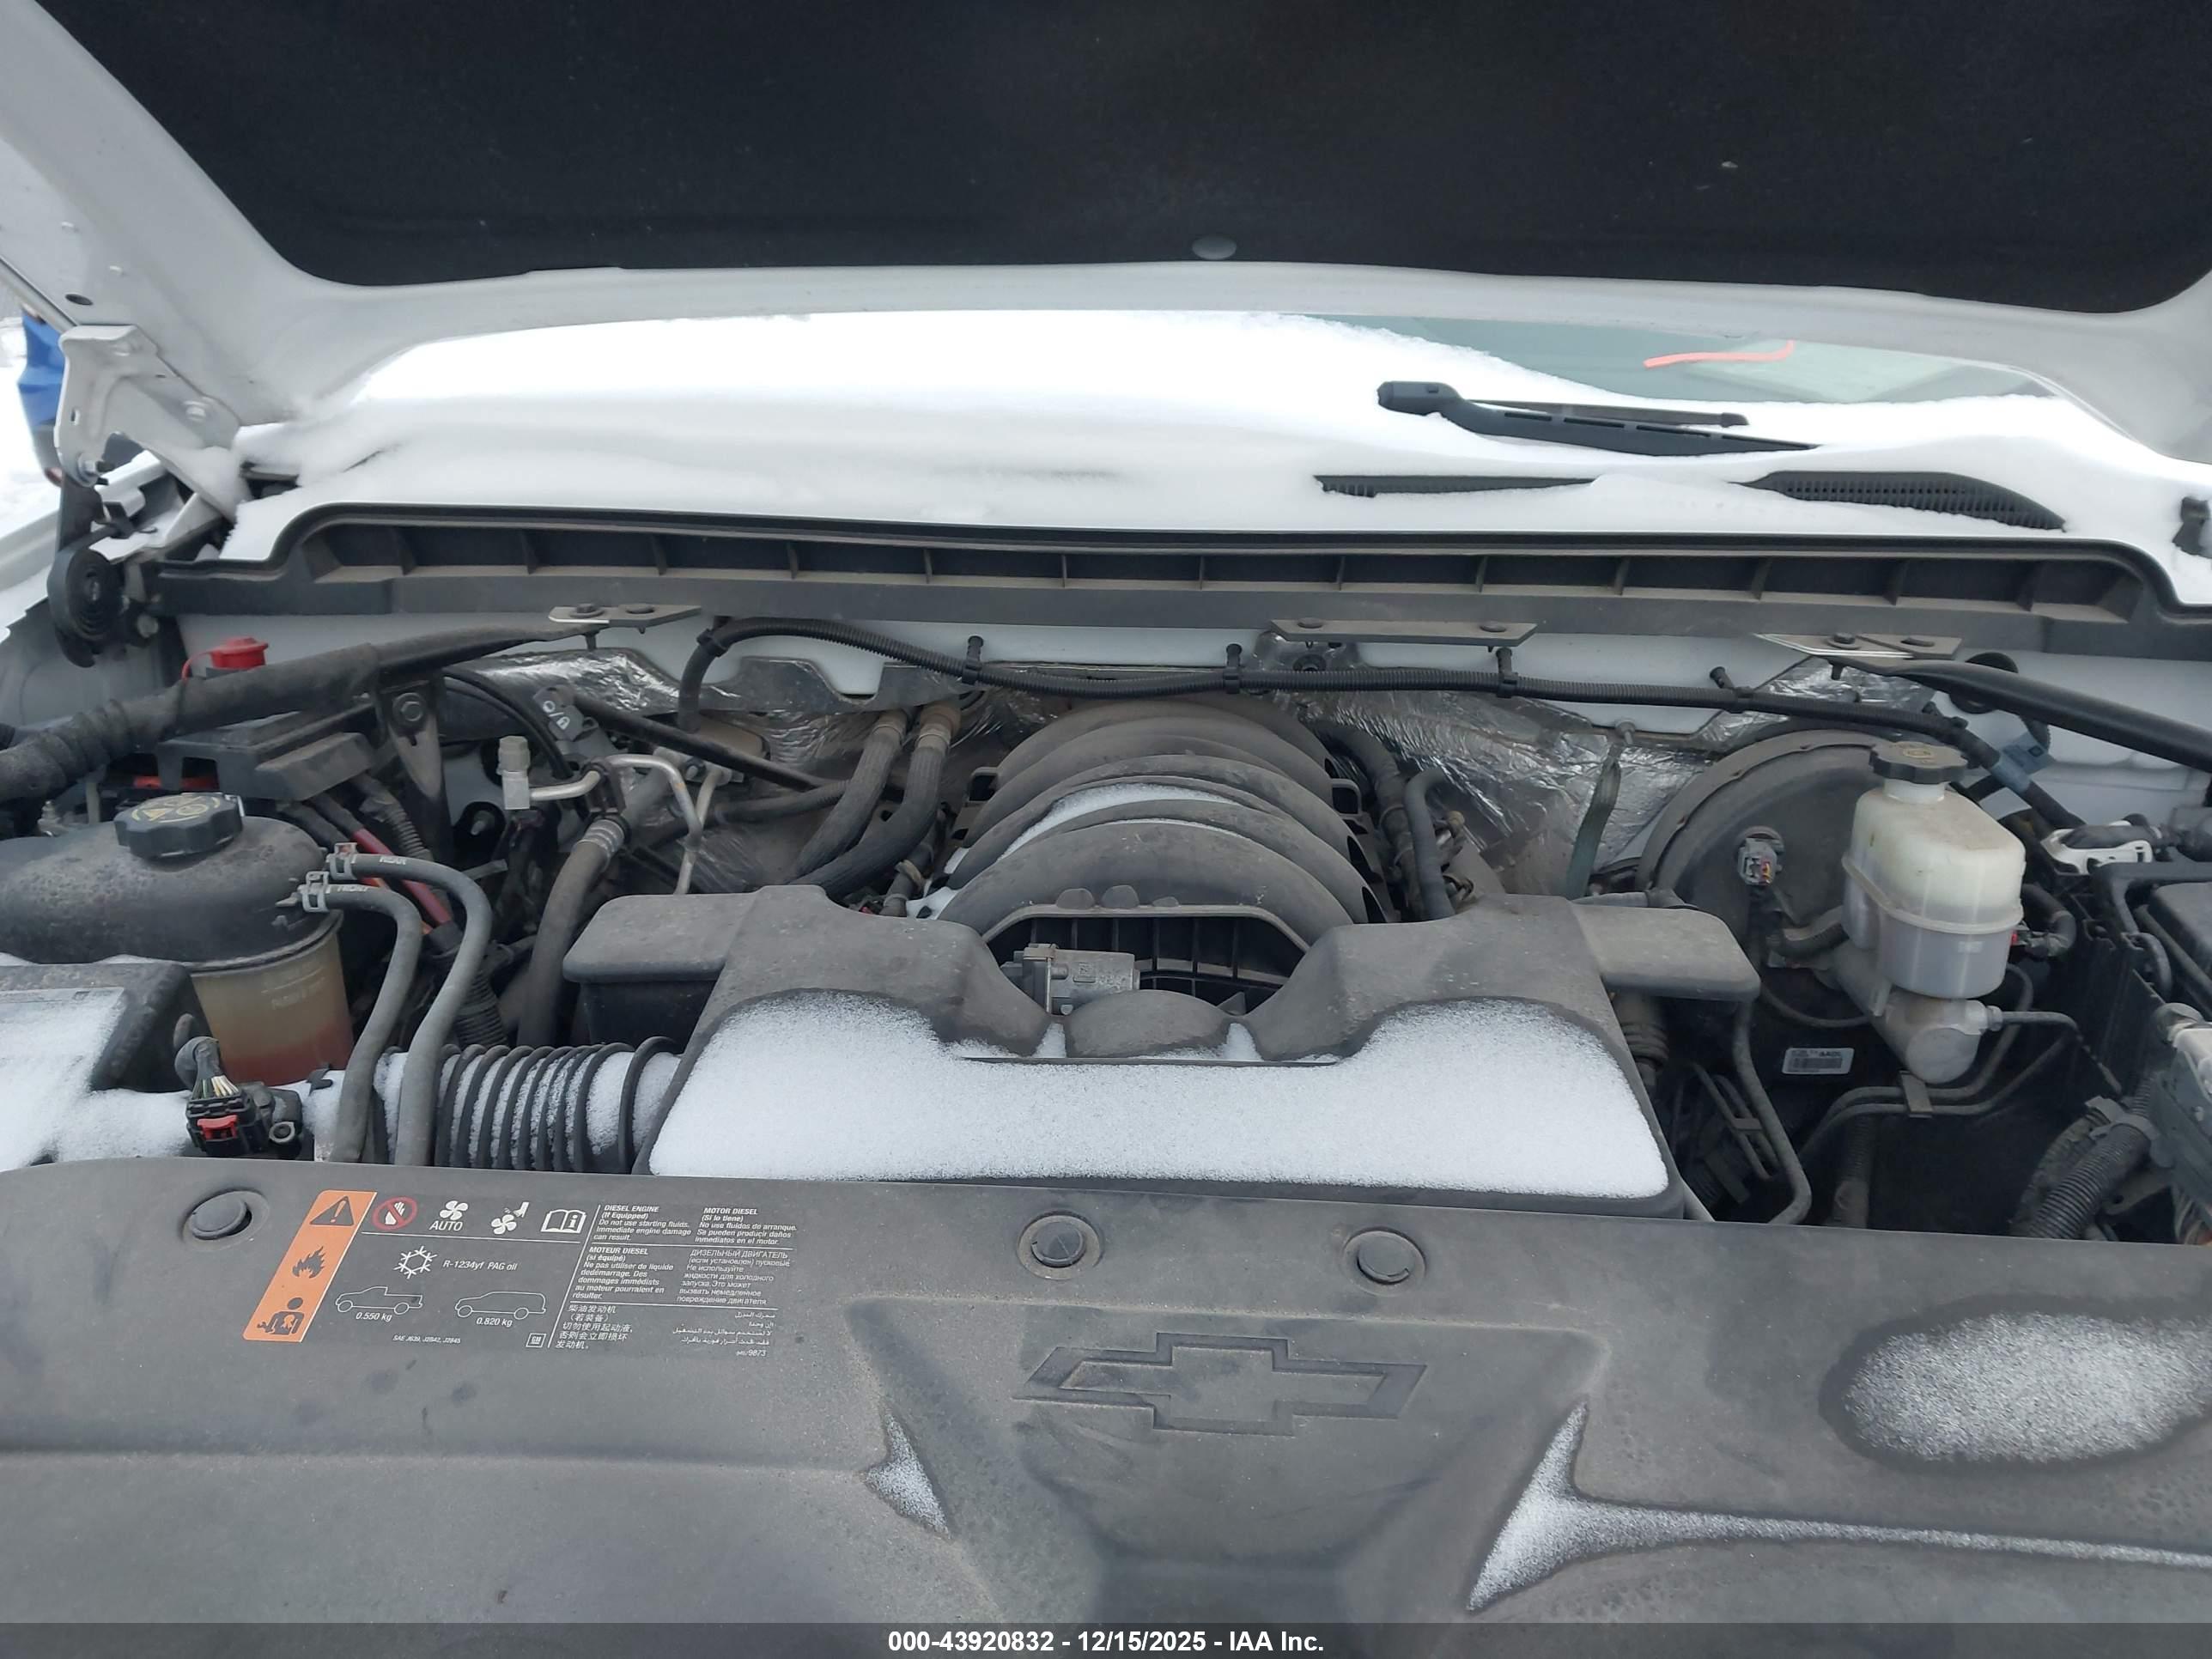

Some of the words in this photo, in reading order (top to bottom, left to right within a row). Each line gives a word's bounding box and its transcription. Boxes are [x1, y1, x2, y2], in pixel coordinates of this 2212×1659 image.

[611, 1212, 649, 1220] Equipped)
[428, 1220, 464, 1231] AUTO
[690, 1249, 741, 1258] ДИЗЕЛЬНЫЙ
[741, 1250, 788, 1259] ДВИГАТЕЛЬ
[442, 1260, 484, 1271] R-1234yf
[487, 1261, 506, 1270] PAG
[507, 1262, 518, 1271] oil
[577, 1277, 620, 1285] dommages
[613, 1285, 654, 1294] pourraient
[568, 1304, 617, 1314] 柴油发动机
[356, 1311, 380, 1321] 0.550
[381, 1313, 392, 1323] kg
[476, 1316, 501, 1326] 0.820
[501, 1318, 513, 1328] kg
[558, 1331, 629, 1341] 否则会立即损坏
